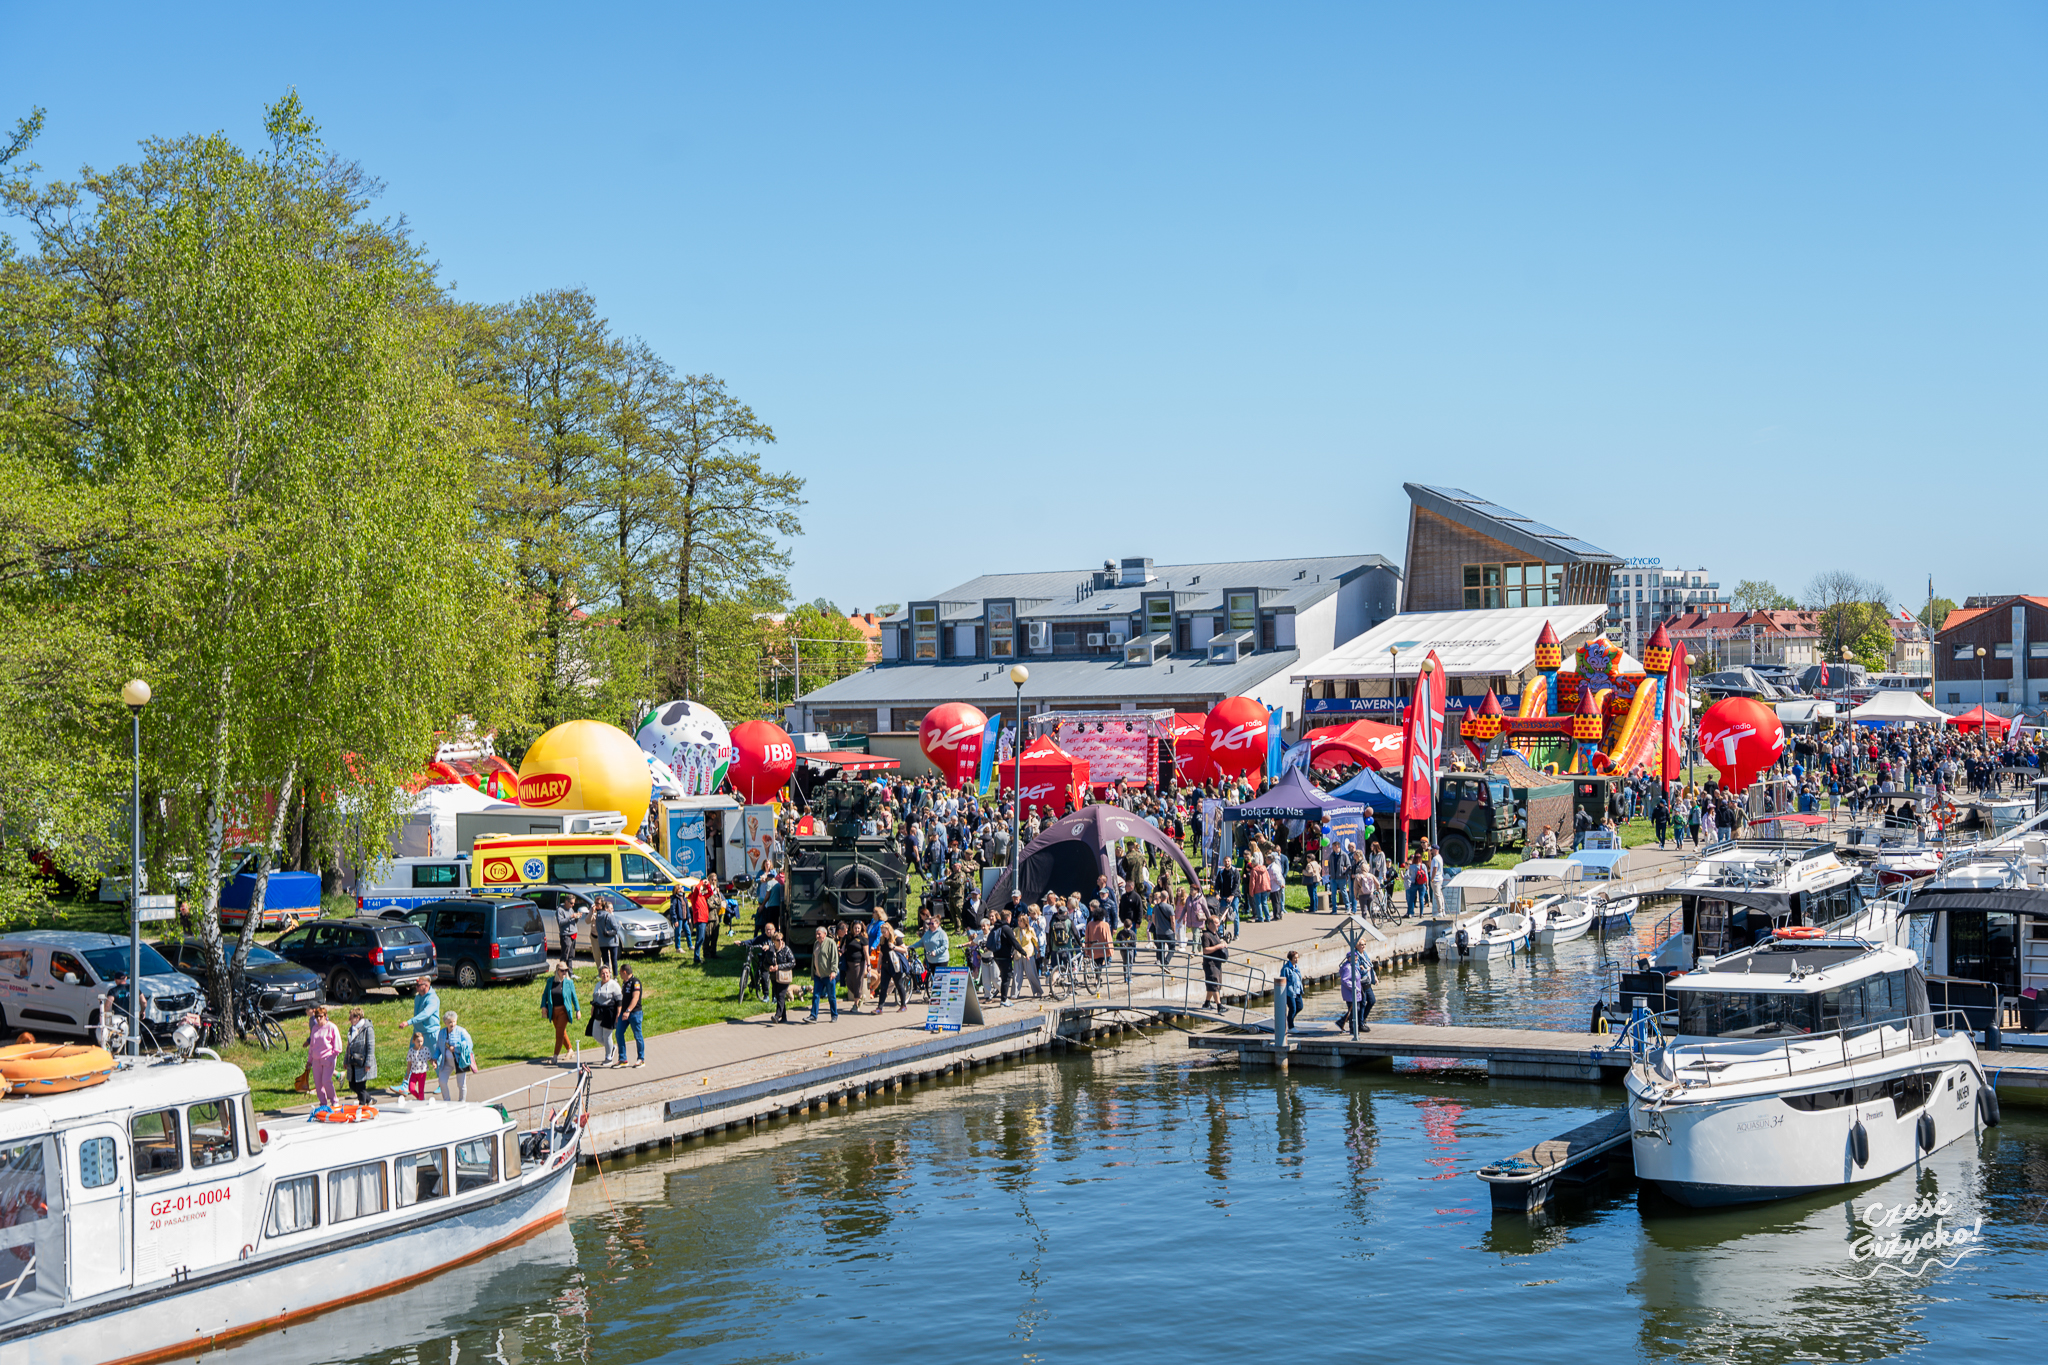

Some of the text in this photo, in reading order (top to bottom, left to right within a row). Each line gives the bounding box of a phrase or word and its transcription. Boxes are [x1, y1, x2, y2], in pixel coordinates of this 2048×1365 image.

[1350, 698, 1463, 710] TAWERNA NA
[1245, 719, 1262, 727] radio
[1210, 724, 1267, 752] ZET
[762, 743, 793, 764] JBB
[1023, 750, 1055, 759] ZET
[519, 779, 568, 800] WINIARY
[1019, 785, 1056, 800] ZET
[1240, 806, 1304, 817] Dołącz do Nas
[1737, 1114, 1784, 1131] AQUASUN 34
[150, 1211, 207, 1231] 20 PASAŻERÓW
